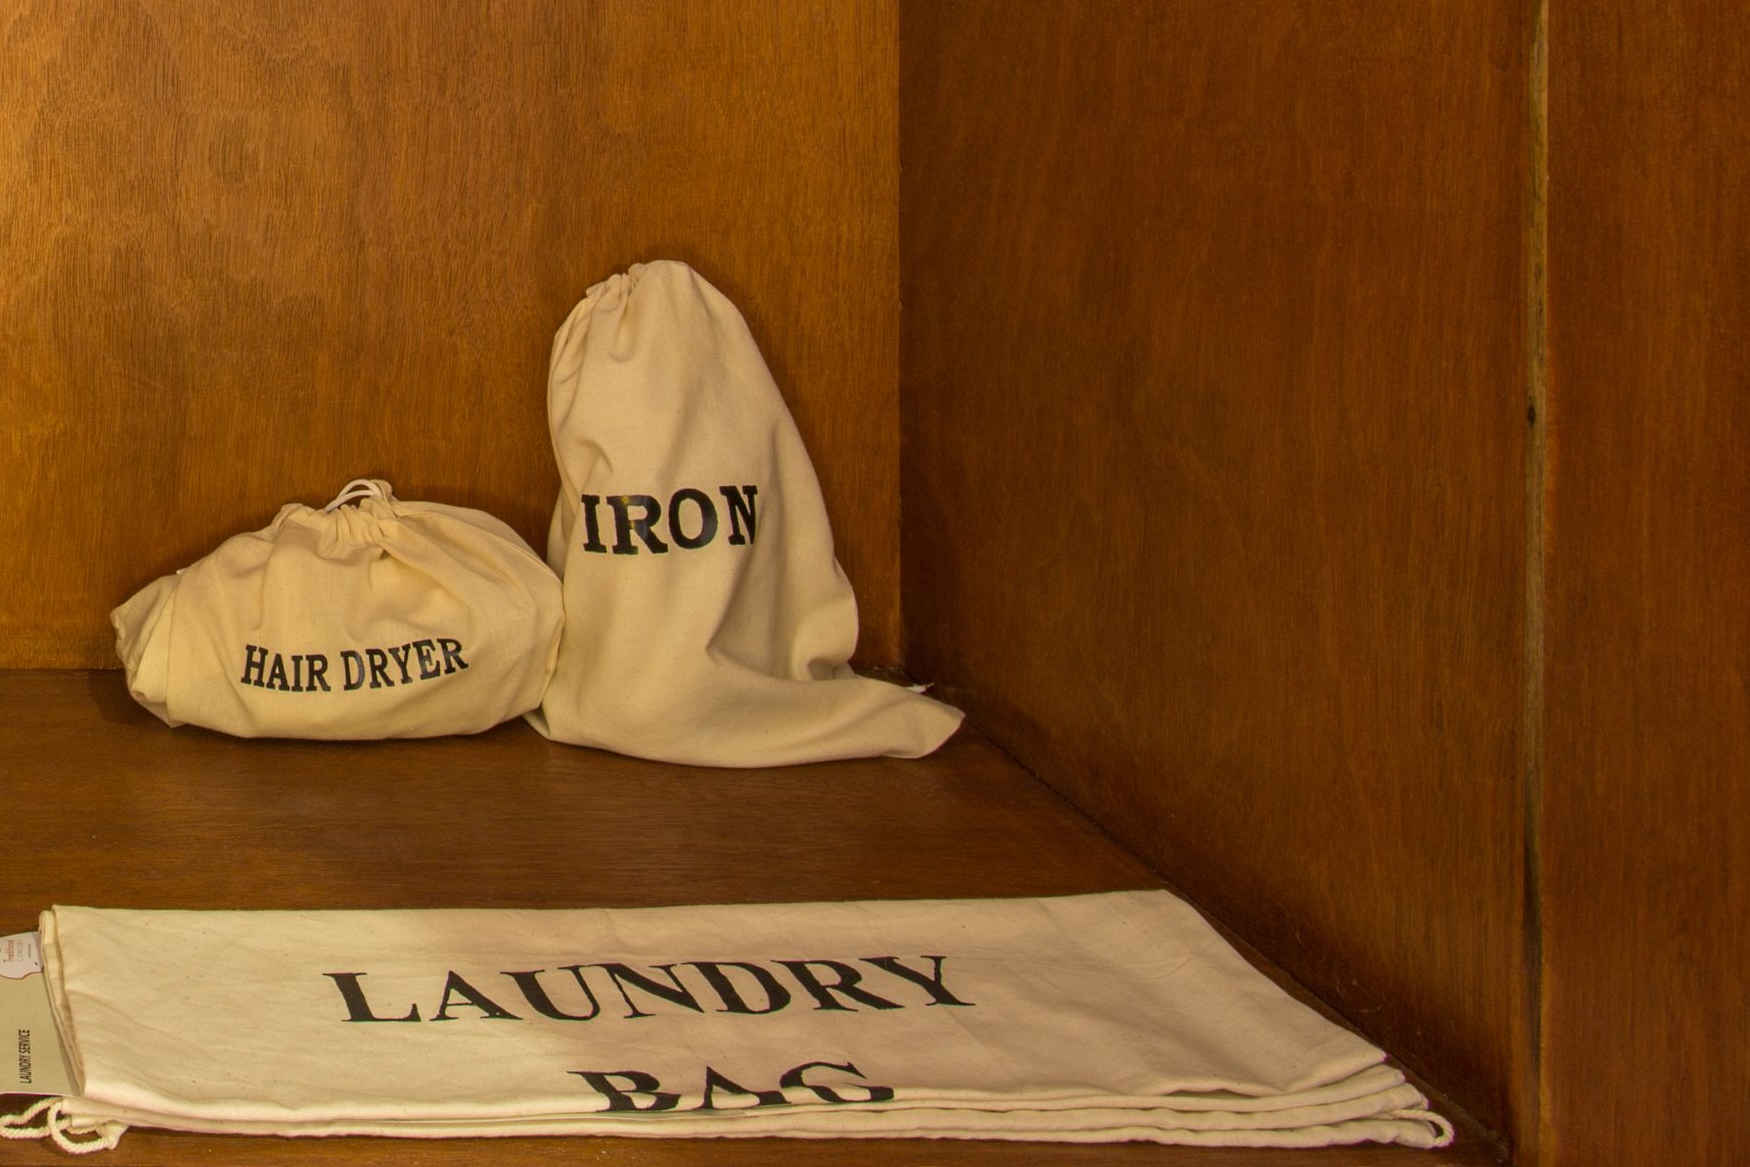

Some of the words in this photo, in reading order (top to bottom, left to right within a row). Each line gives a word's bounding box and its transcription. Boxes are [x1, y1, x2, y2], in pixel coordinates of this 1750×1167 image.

[581, 485, 758, 555] IRON
[241, 644, 331, 692] HAIR
[340, 638, 469, 691] DRYER
[322, 955, 977, 1023] LAUNDRY
[18, 1028, 31, 1054] SERVICE
[18, 1054, 32, 1084] LAUNDRY
[566, 1061, 895, 1113] BAG
